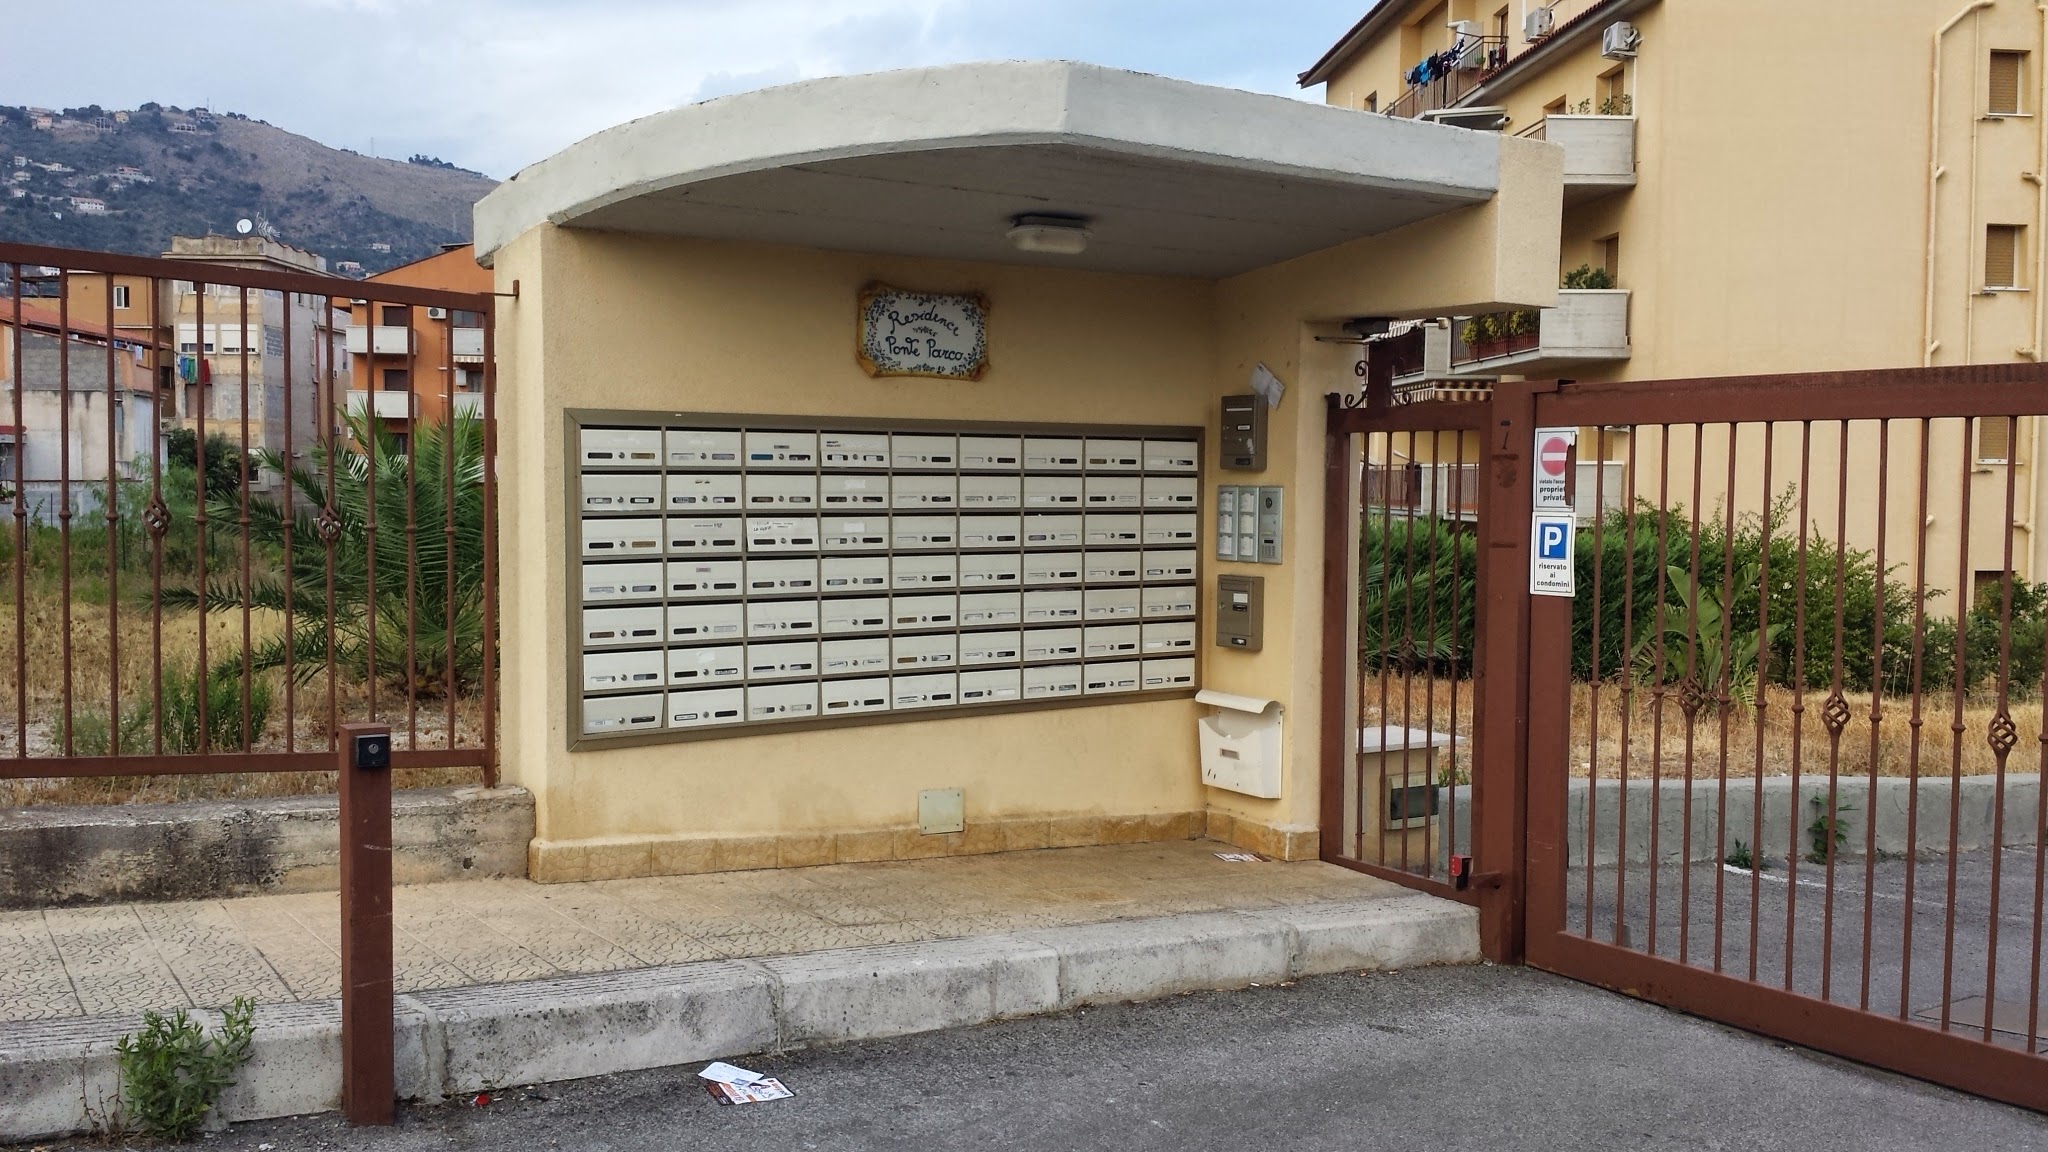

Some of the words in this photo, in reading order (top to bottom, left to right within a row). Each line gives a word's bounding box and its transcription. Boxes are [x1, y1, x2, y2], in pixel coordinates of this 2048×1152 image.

[887, 304, 960, 337] Residence
[885, 335, 921, 357] Ponte
[926, 338, 965, 361] Parco
[1543, 526, 1563, 556] P
[1538, 562, 1568, 571] riservato
[1536, 580, 1570, 588] condomini
